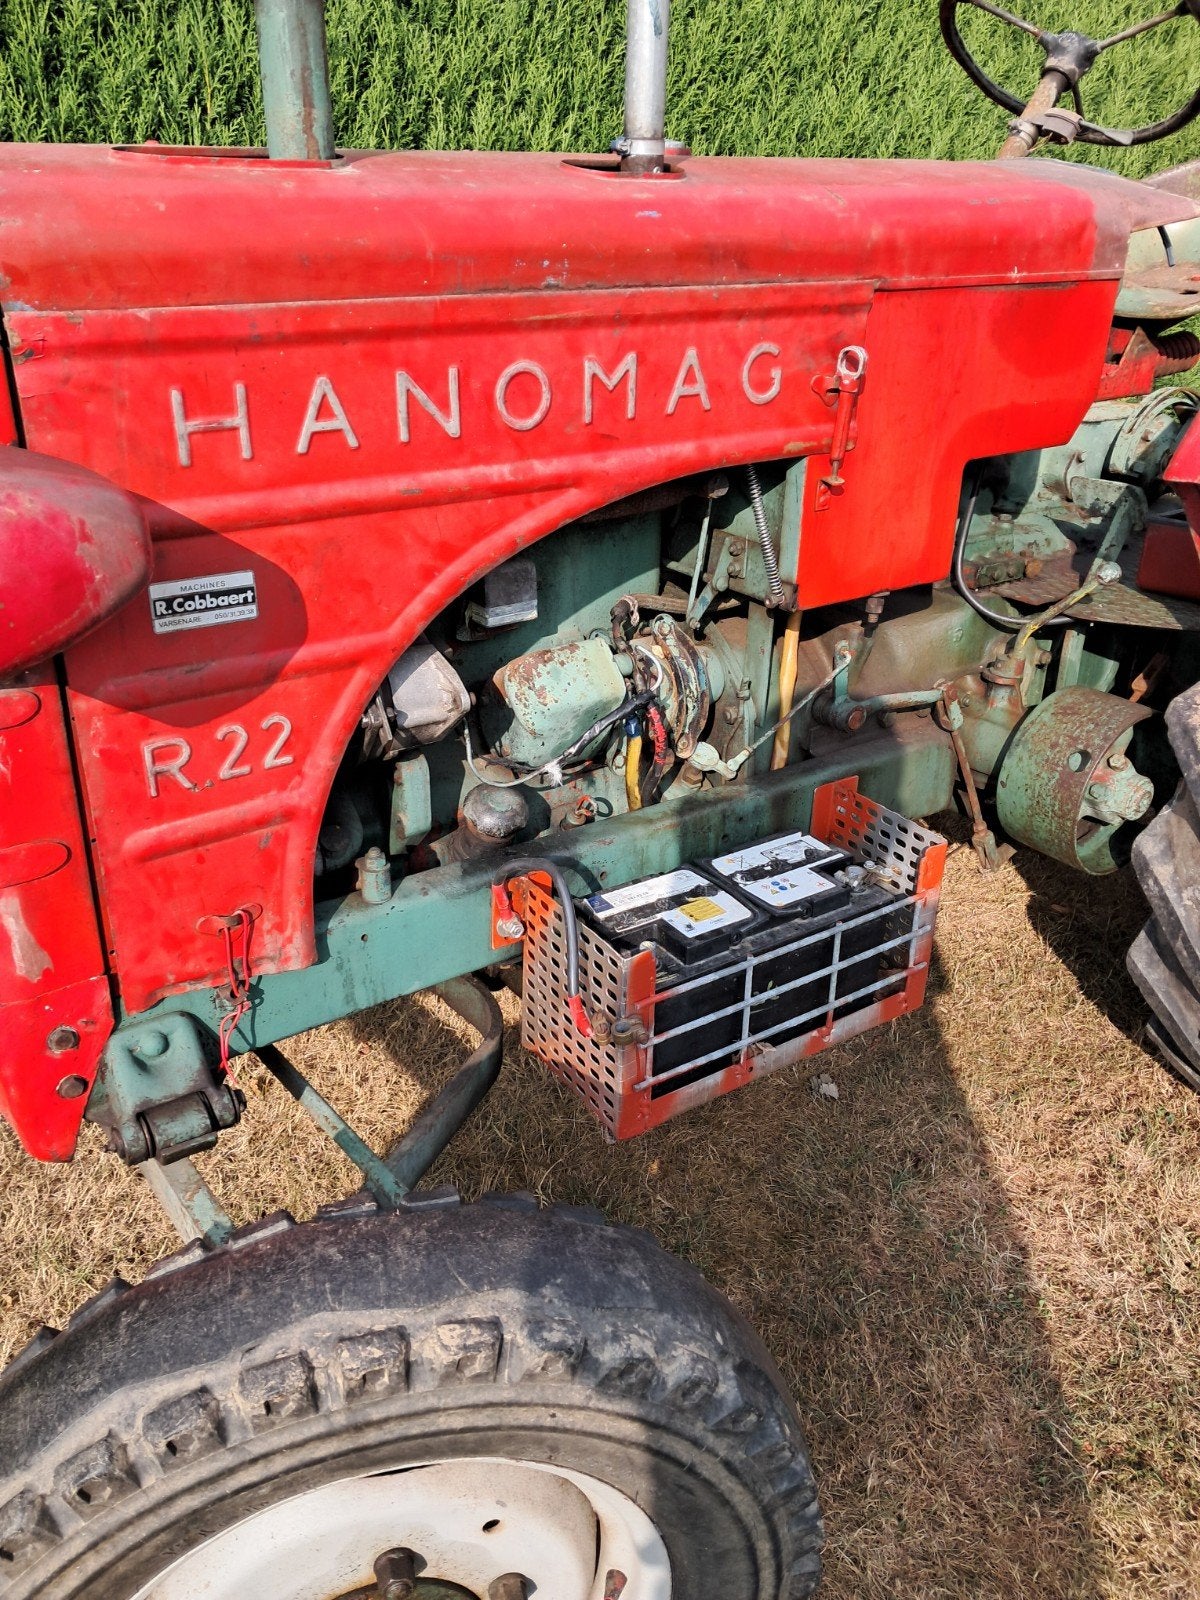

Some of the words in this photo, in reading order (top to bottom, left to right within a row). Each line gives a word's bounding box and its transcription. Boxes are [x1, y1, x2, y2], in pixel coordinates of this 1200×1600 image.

[170, 342, 783, 467] HANOMAG
[180, 580, 226, 592] MACHINES
[158, 615, 202, 628] VARSENARE
